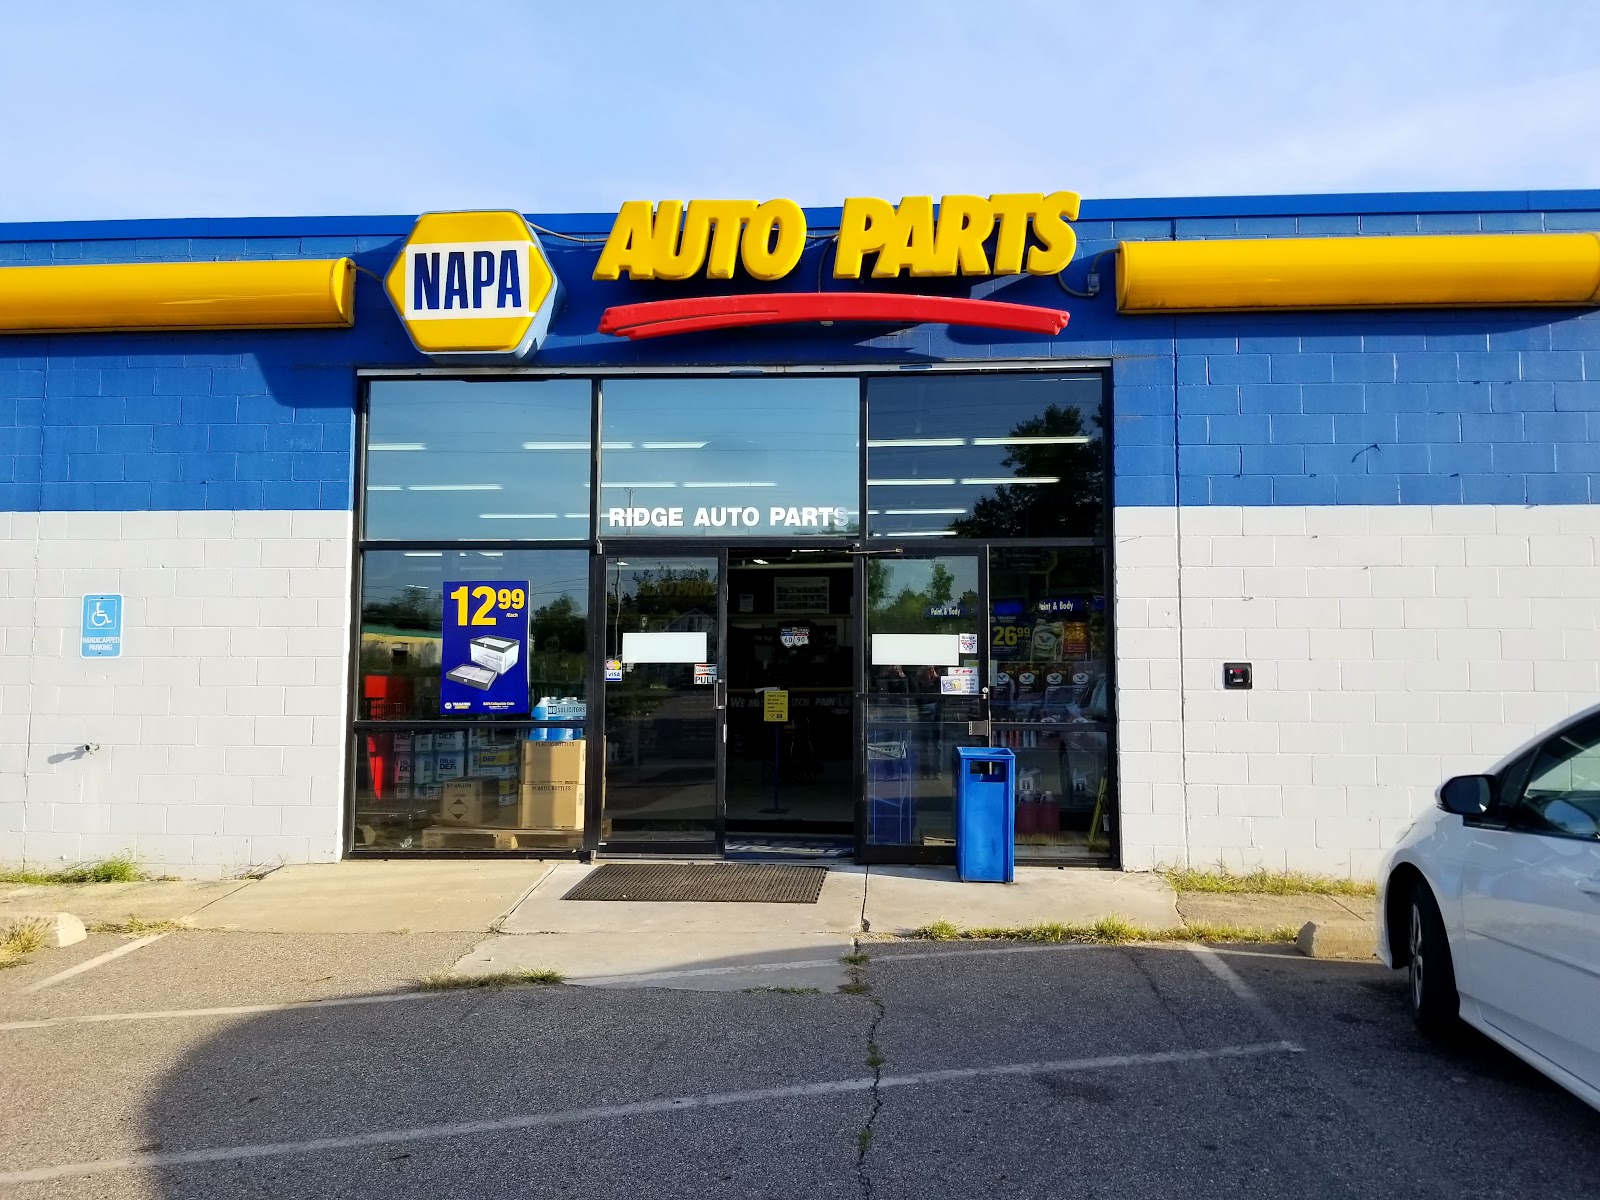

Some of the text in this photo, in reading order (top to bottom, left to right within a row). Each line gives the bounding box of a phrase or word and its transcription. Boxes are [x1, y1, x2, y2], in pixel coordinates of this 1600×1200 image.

[592, 190, 1082, 281] AUTO PARTS
[413, 249, 522, 310] NAPA
[608, 507, 850, 527] RIDGE AUTO PARTS
[948, 606, 961, 617] Body
[1059, 601, 1074, 612] Body
[82, 636, 120, 644] HANDICAPPED
